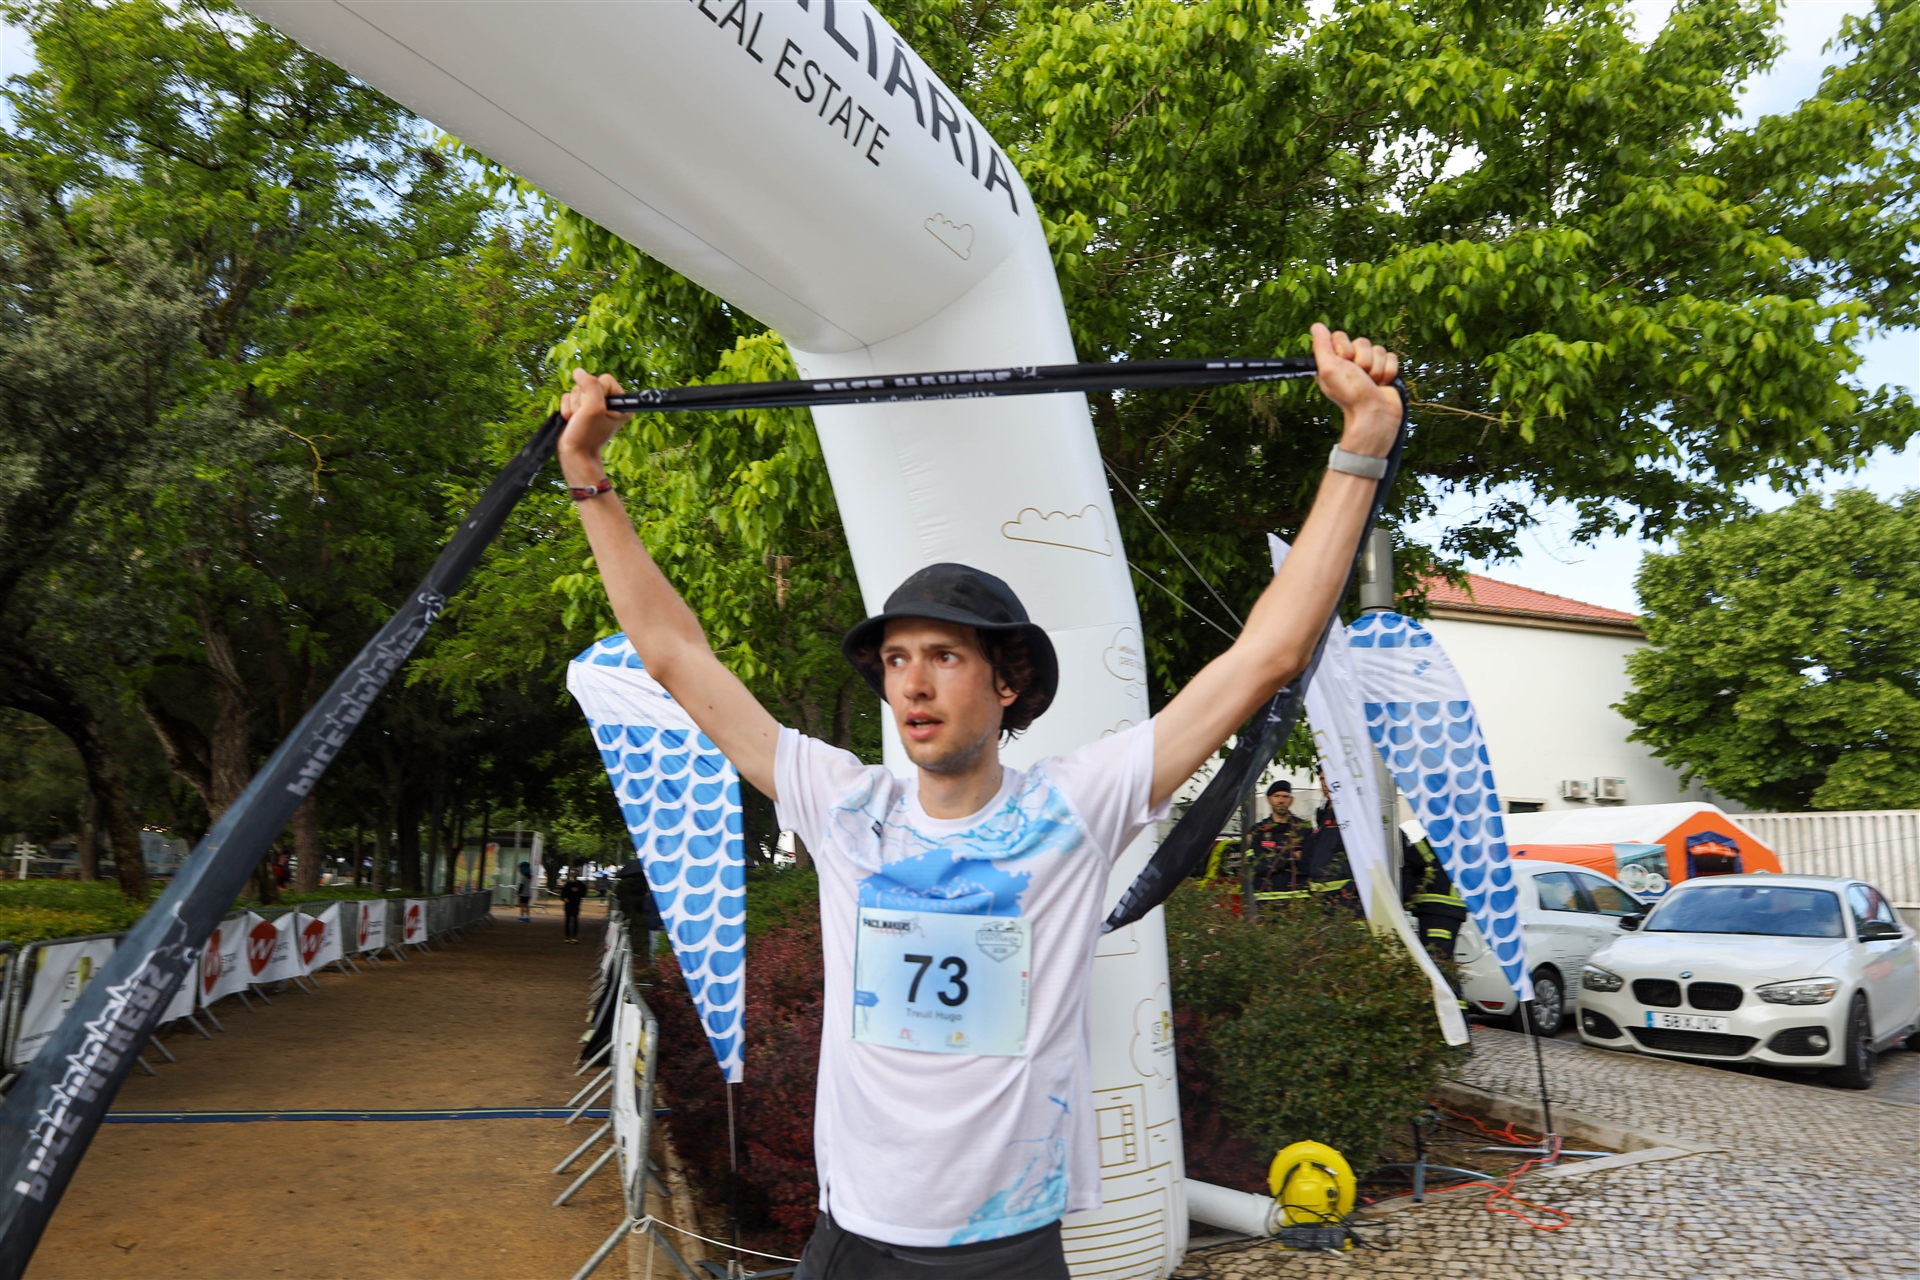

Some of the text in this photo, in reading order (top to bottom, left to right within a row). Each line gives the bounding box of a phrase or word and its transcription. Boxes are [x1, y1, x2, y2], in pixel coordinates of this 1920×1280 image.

[774, 38, 890, 167] ESTATE
[904, 954, 969, 1007] 73
[935, 1011, 963, 1022] Hugo
